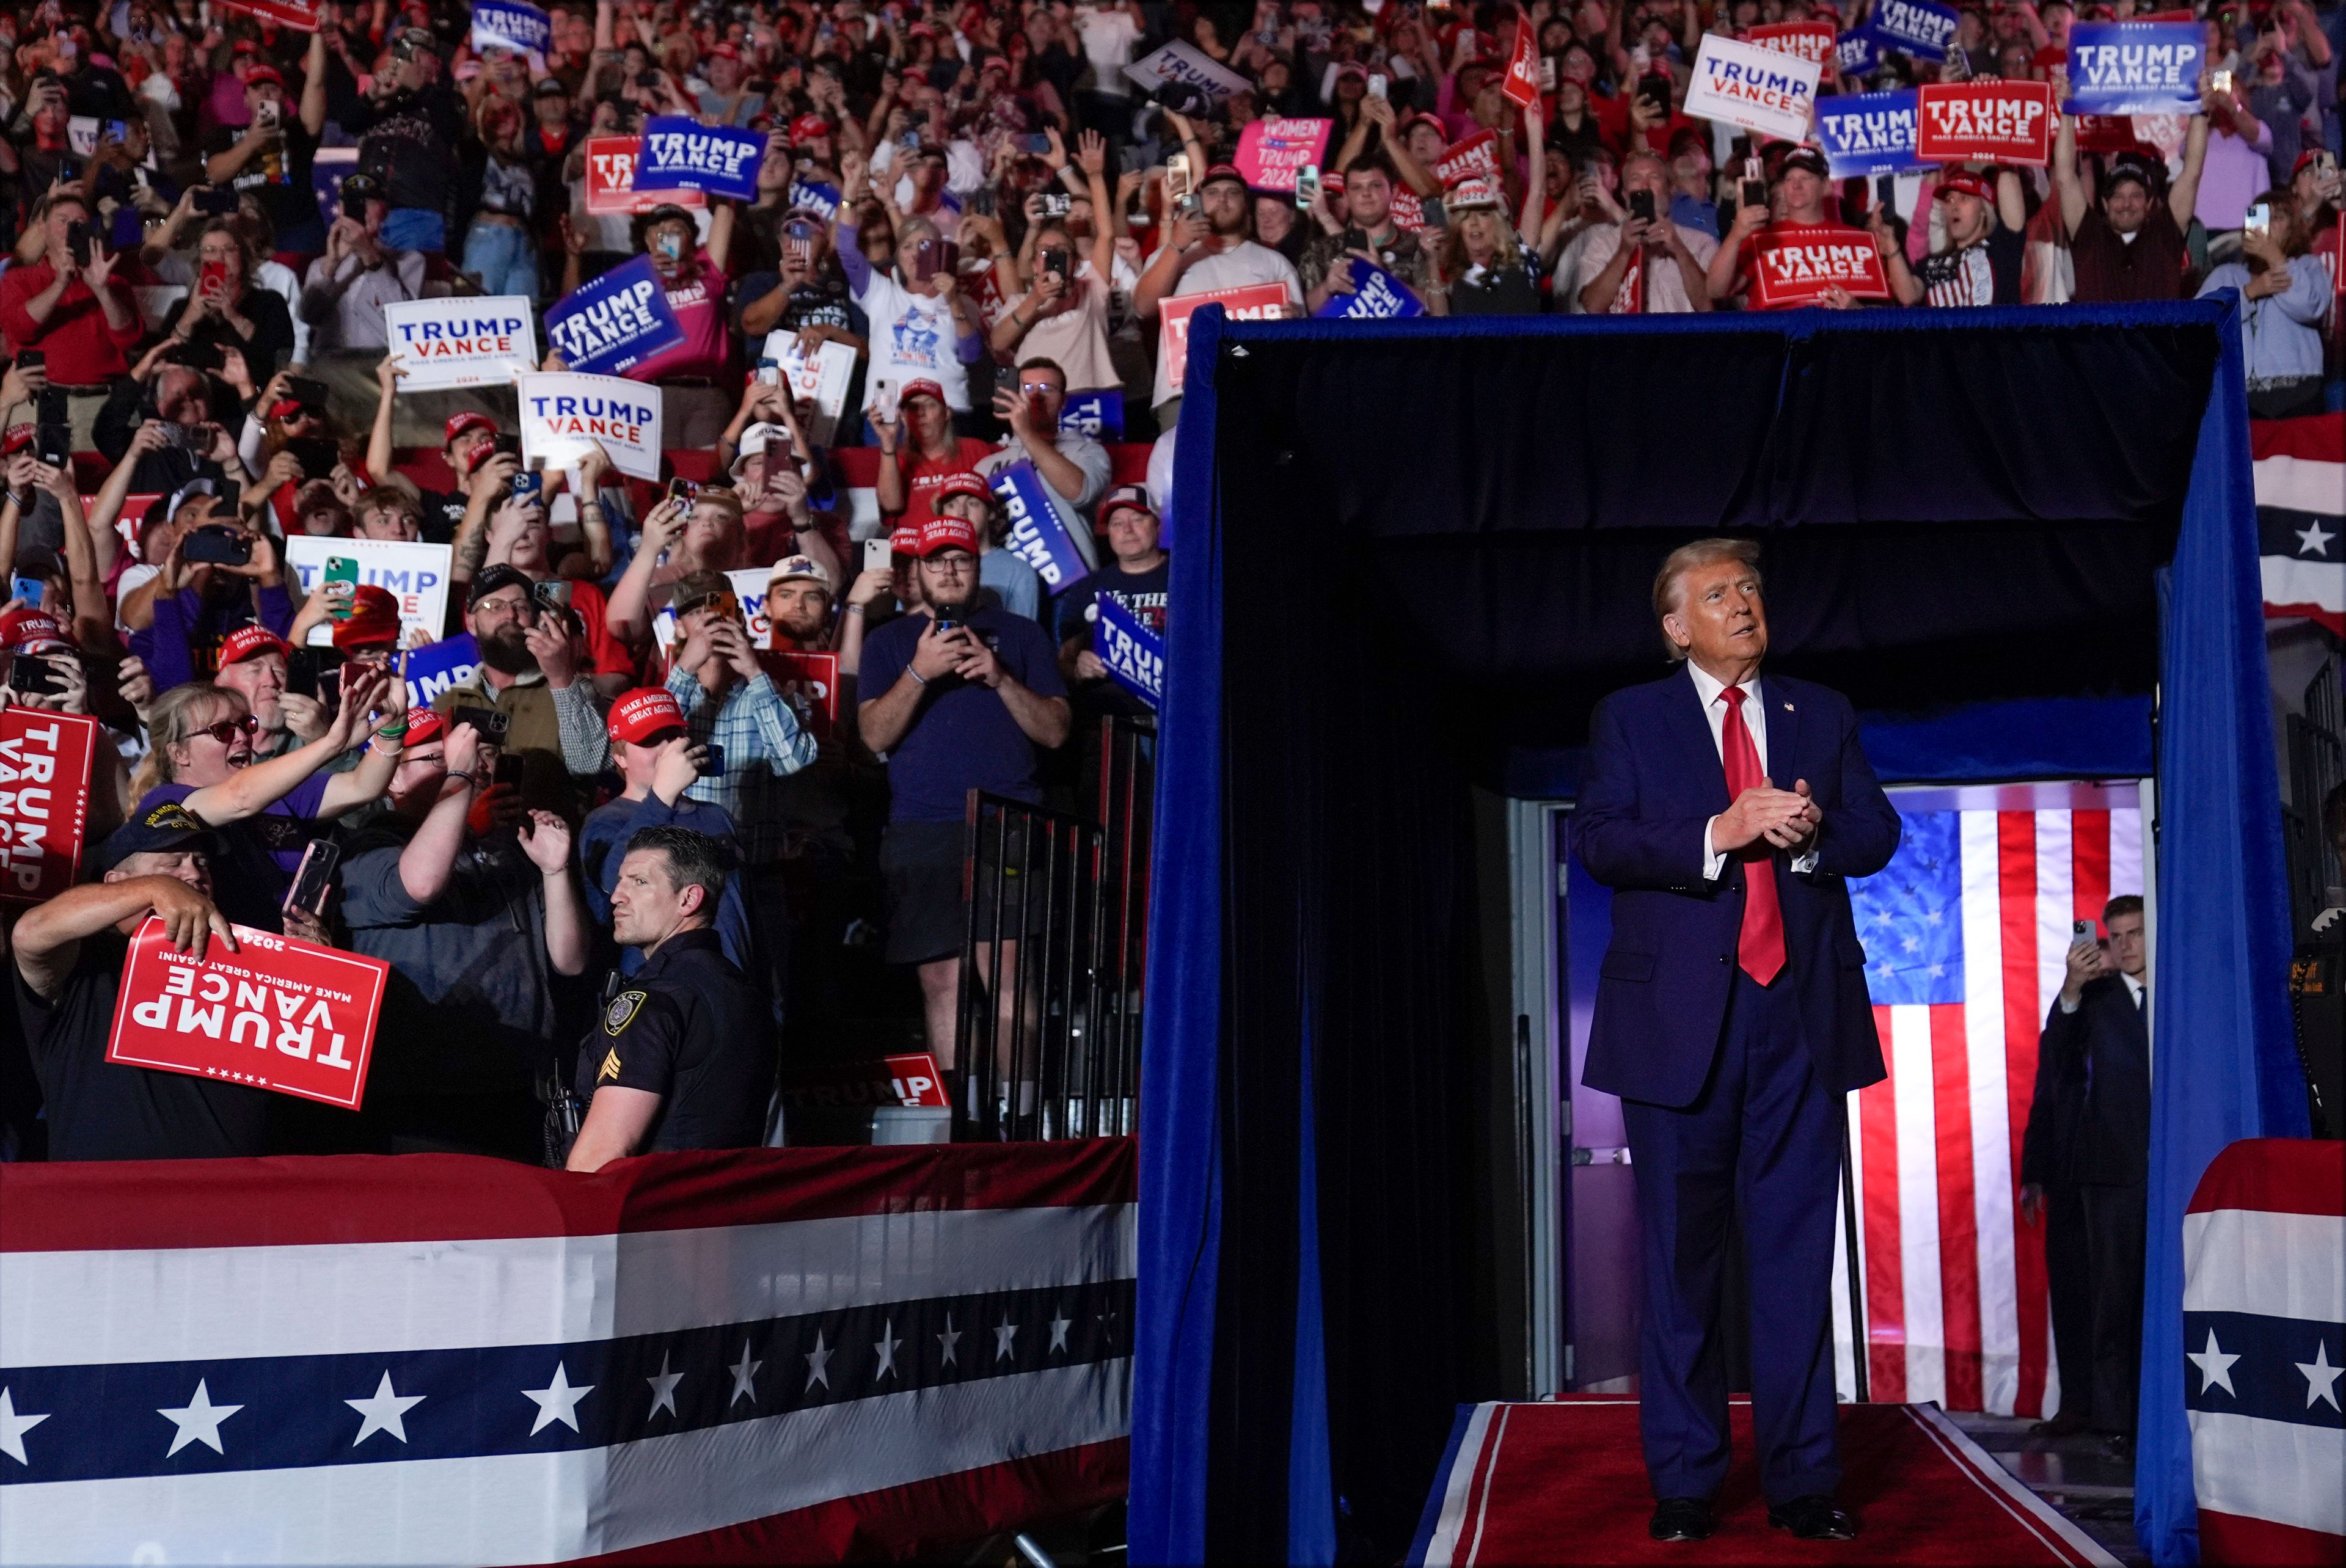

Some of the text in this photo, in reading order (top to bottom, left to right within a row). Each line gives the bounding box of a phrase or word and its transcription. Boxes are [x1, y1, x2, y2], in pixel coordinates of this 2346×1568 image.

[1880, 0, 1956, 32] TRUMP
[1884, 12, 1944, 43] VANCE
[2075, 44, 2197, 67] TRUMP
[1160, 50, 1230, 96] TRUMP
[1706, 56, 1808, 96] TRUMP
[2087, 65, 2180, 84] VANCE
[1714, 77, 1793, 110] VANCE
[1926, 98, 2044, 120] TRUMP
[1263, 119, 1321, 137] WOMEN
[1822, 108, 1918, 136] TRUM
[1939, 117, 2031, 137] VANCE
[648, 133, 758, 160] TRUMP
[1257, 148, 1312, 167] TRUMP
[656, 150, 742, 173] VANCE
[1762, 245, 1873, 268] TRUMP
[1777, 260, 1866, 278] VANCE
[551, 279, 655, 346] TRUMP
[398, 318, 522, 341] TRUMP
[565, 304, 653, 357] VANCE
[414, 337, 512, 357] VANCE
[456, 376, 480, 384] 2024
[530, 396, 653, 426] TRUMP
[546, 417, 641, 444] VANCE
[923, 519, 971, 532] MAKE AMERICA
[926, 529, 970, 541] GREAT AGAIN
[995, 475, 1062, 586] TRUMP
[232, 627, 252, 642] MAKE
[236, 635, 260, 651] GREAT
[619, 694, 674, 717] MAKE AMERICA
[627, 704, 676, 726] GREAT AGAIN
[409, 712, 436, 729] GREAT
[10, 723, 59, 892] TRUMP
[145, 813, 159, 826] USS
[243, 932, 285, 952] 2024
[158, 950, 352, 1004] MAKE AMERICA GREAT AGAIN!
[165, 965, 334, 1031] VANCE
[132, 993, 352, 1071] TRUMP
